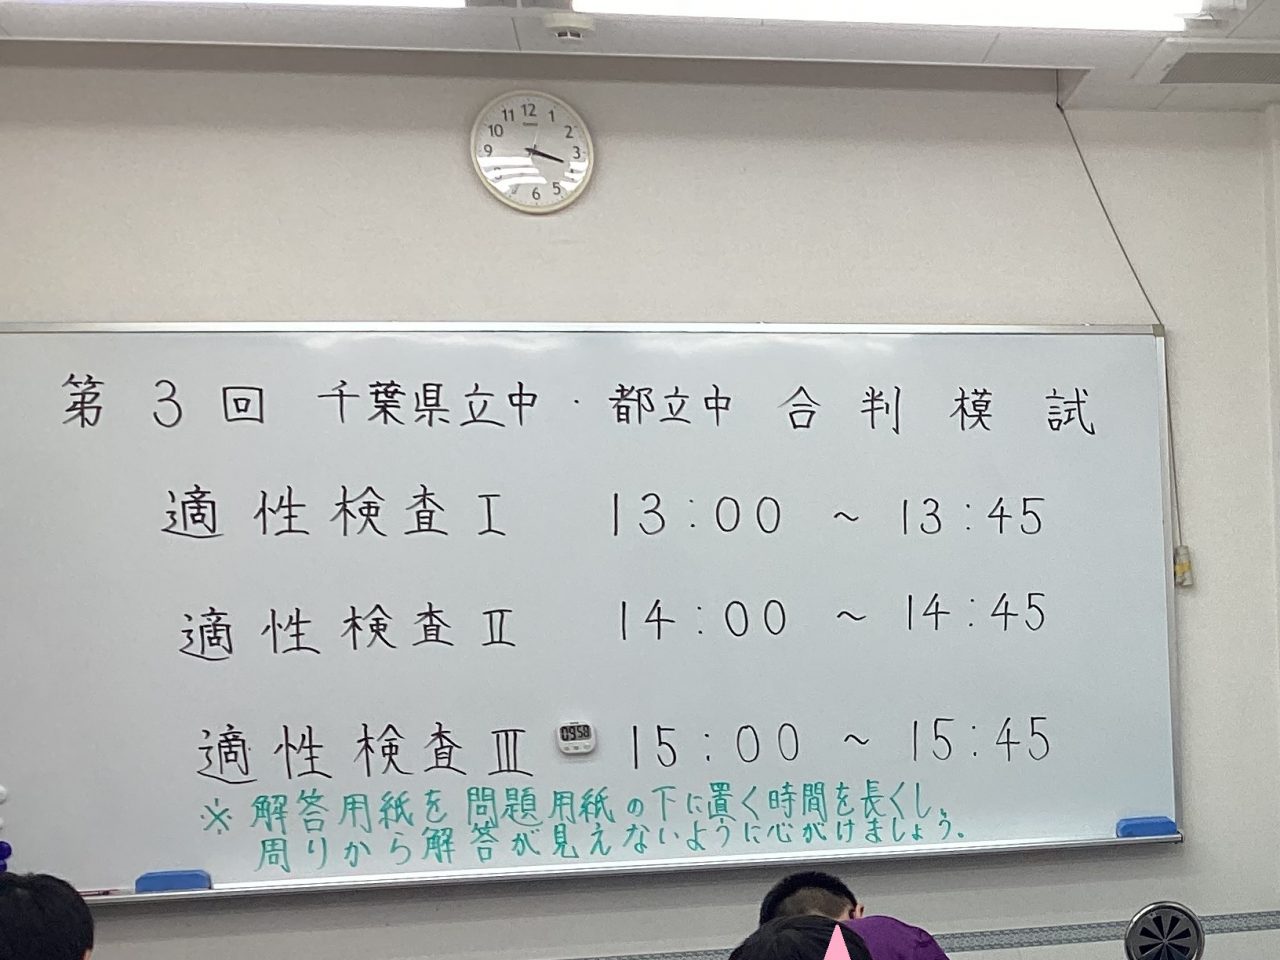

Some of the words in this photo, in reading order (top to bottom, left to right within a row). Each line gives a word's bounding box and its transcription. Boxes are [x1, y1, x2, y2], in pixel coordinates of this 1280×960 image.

[502, 109, 514, 122] 11
[521, 103, 536, 117] 12
[549, 110, 555, 122] 1
[489, 124, 504, 137] 10
[565, 125, 574, 138] 2
[483, 144, 492, 157] 9
[572, 145, 581, 159] 3
[532, 187, 541, 200] 6
[552, 182, 561, 195] 5
[613, 493, 781, 537] 13:00
[902, 496, 1046, 536] 13:45
[621, 599, 787, 641] 14:00
[907, 592, 1046, 632] 14:45
[632, 723, 800, 770] 15:00
[912, 716, 1051, 763] 15:45
